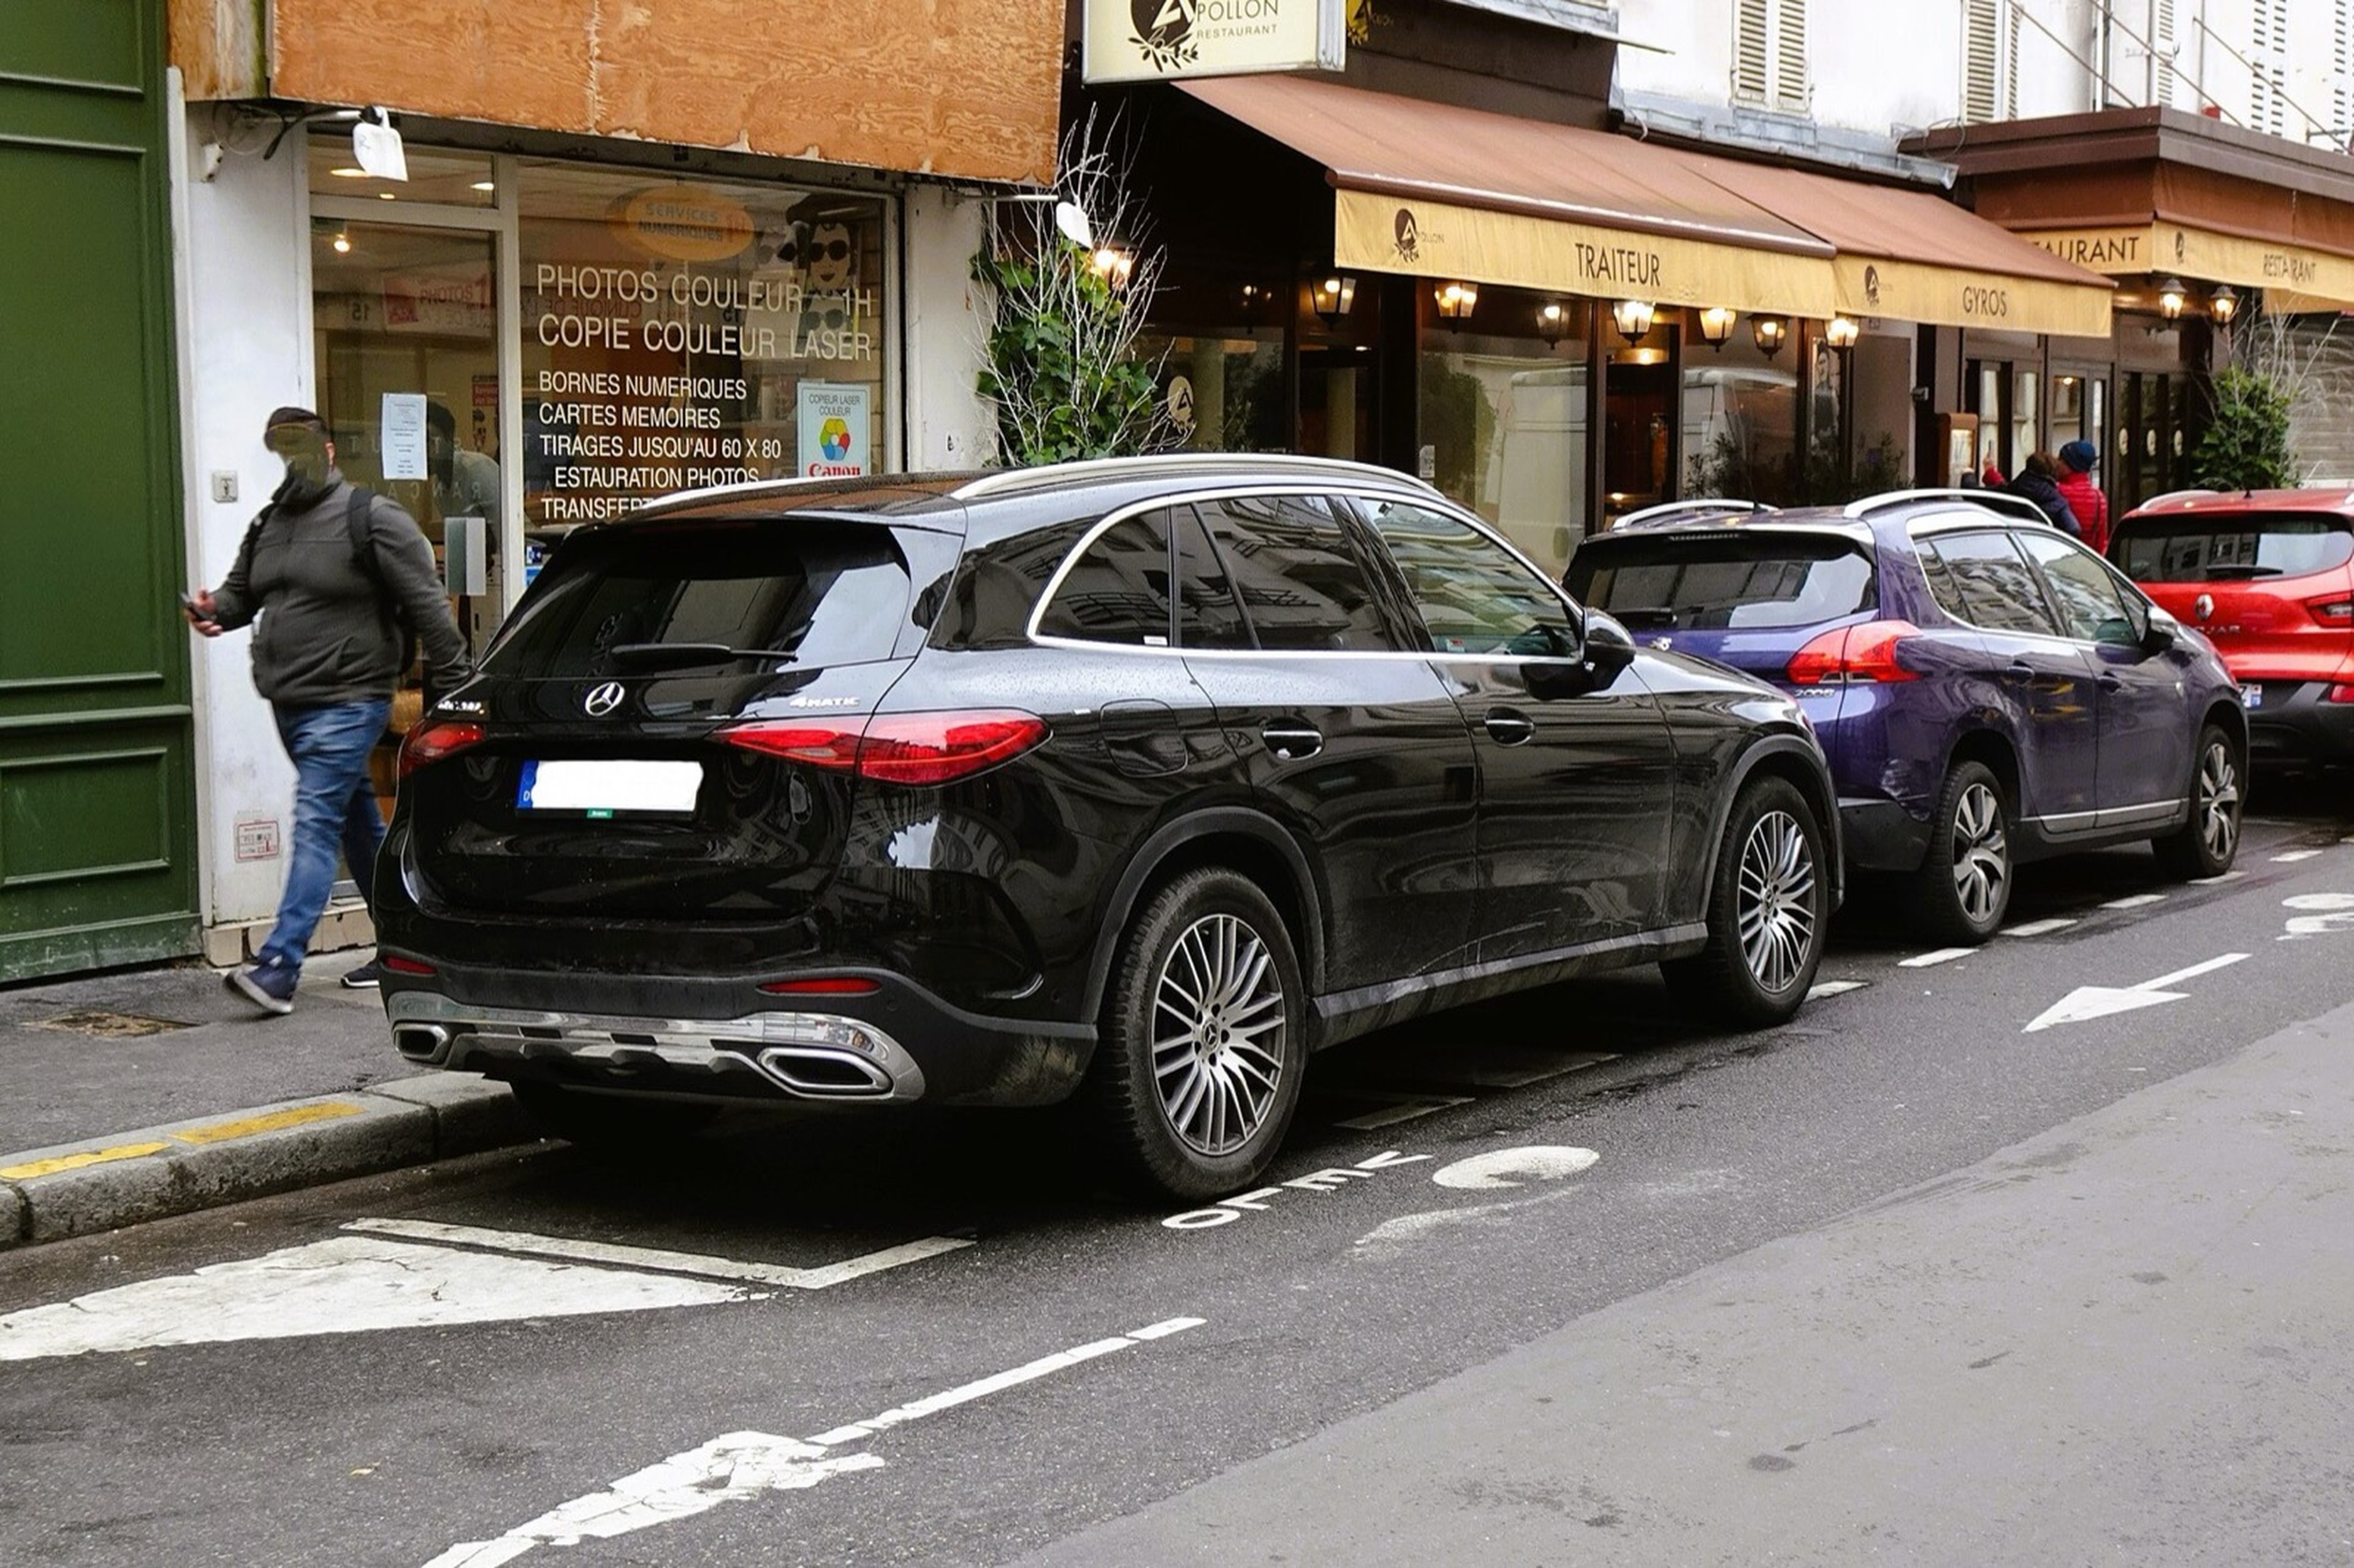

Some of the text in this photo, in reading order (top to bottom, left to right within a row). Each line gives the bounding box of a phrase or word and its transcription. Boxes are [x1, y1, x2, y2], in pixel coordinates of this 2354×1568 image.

[1197, 25, 1277, 39] RESTAURANT
[1575, 243, 1661, 287] TRAITEUR
[2263, 254, 2316, 283] RESTARANT
[537, 264, 870, 317] PHOTOS COULEUR 1H
[1962, 286, 2008, 318] GYROS
[538, 313, 871, 361] COPIE COULEUR LASER
[539, 371, 747, 400] BORNES NUMERIQUES
[840, 395, 861, 406] LASER
[539, 403, 721, 429] CARTES MEMOIRES
[539, 435, 781, 460] TIRAGES JUSQU'AU 60 X 80
[555, 467, 759, 489] ESTAURATION PHOTOS
[809, 463, 861, 478] Canon
